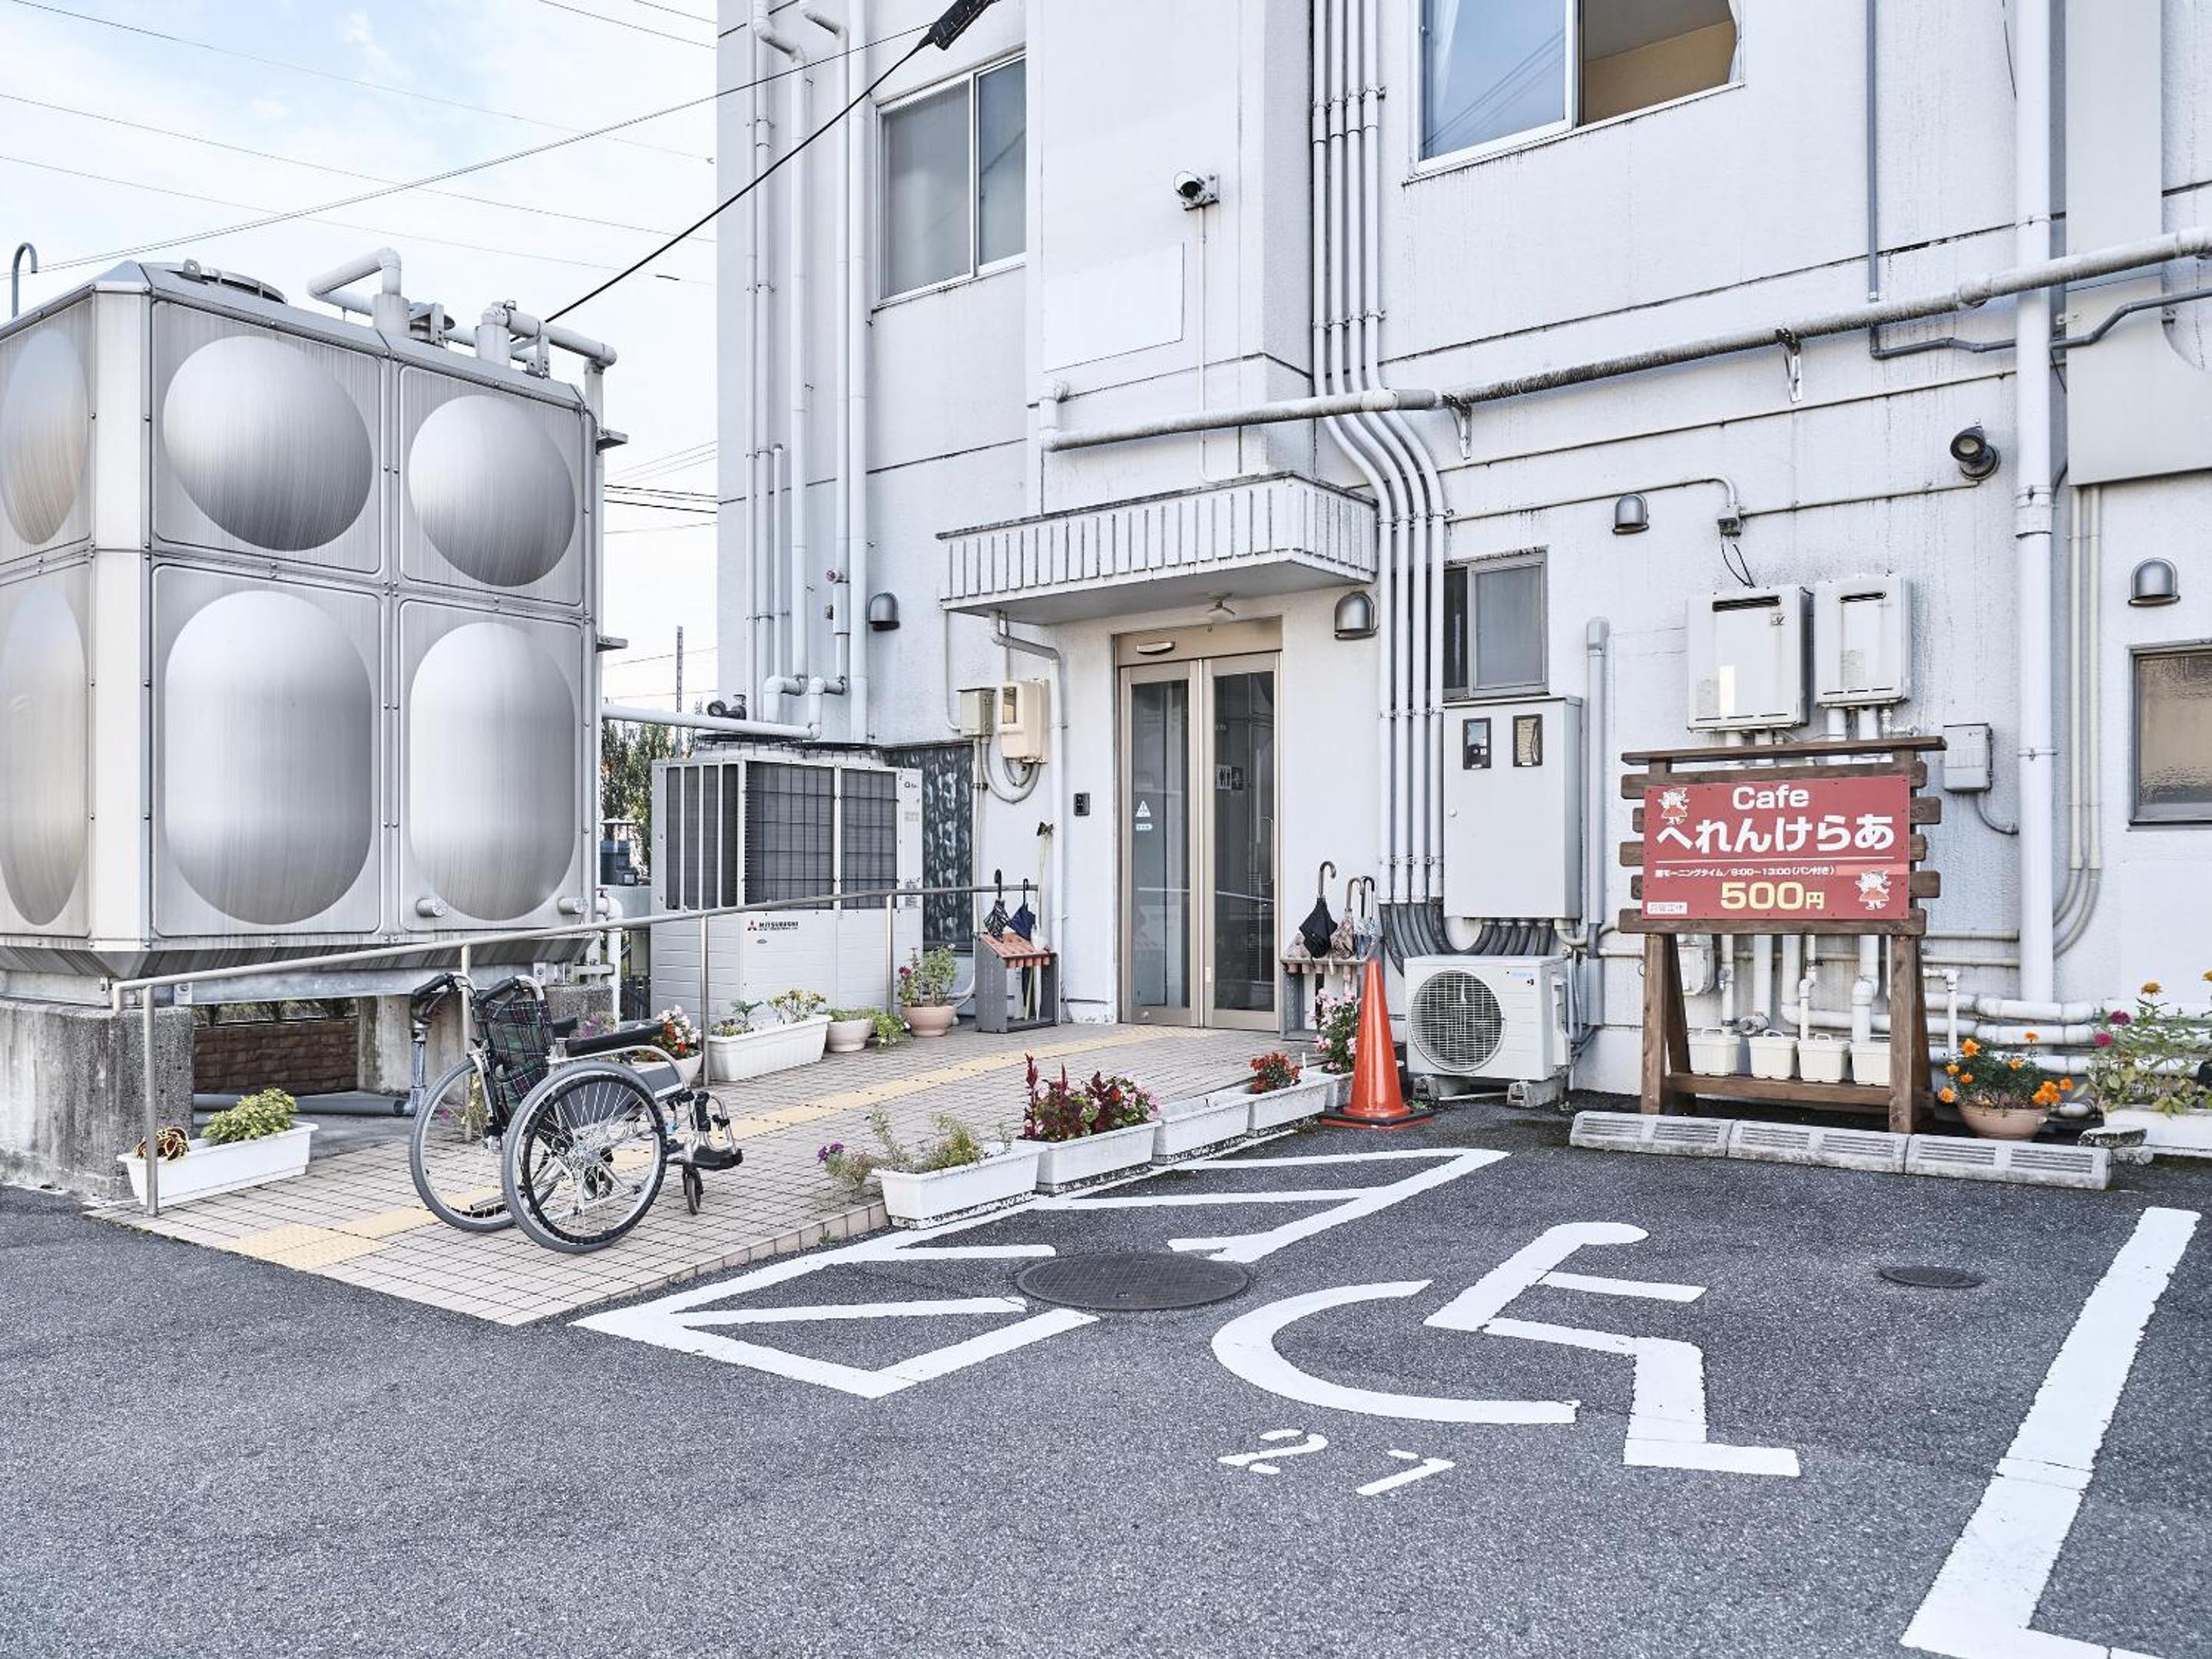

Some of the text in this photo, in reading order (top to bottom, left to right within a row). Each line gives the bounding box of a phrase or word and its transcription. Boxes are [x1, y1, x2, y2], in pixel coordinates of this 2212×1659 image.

[1733, 785, 1810, 810] Cafe
[1657, 813, 1894, 853] へれんけらあ
[1720, 882, 1825, 910] 500円
